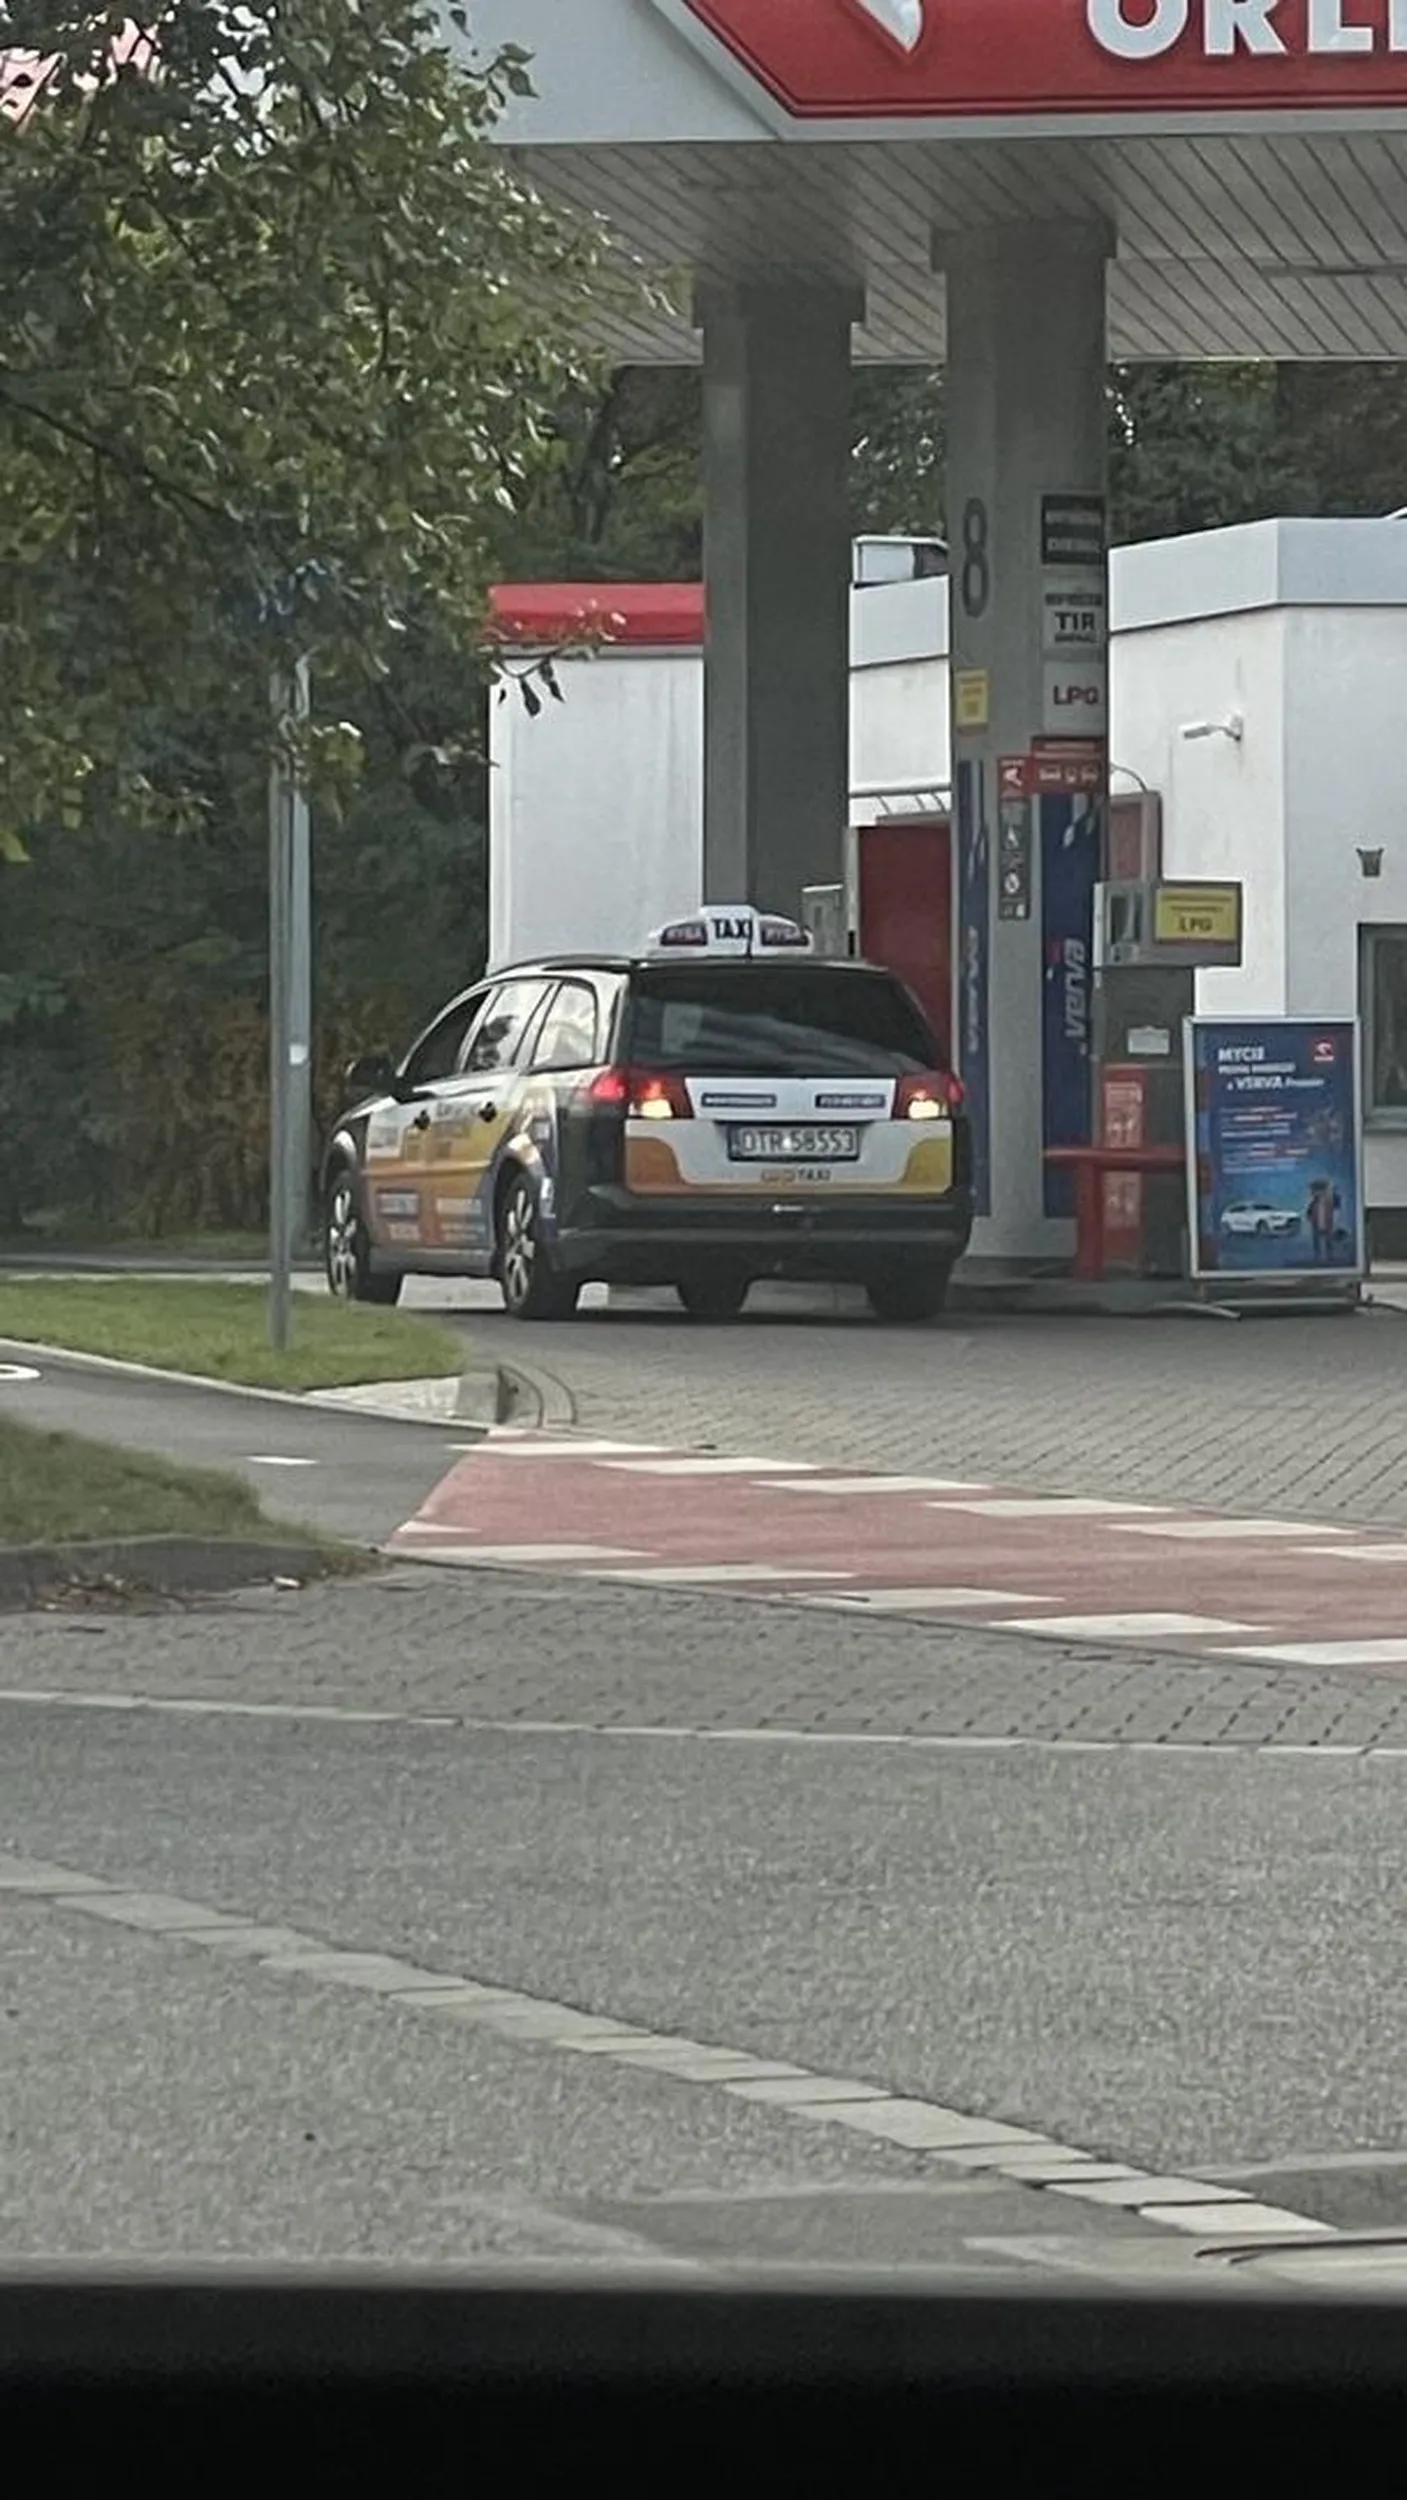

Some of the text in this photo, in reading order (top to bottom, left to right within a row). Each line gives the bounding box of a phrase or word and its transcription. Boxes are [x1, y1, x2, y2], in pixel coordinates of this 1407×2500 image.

[963, 497, 989, 619] 8
[1054, 612, 1095, 631] TIR
[1053, 685, 1099, 706] LPG
[711, 918, 753, 940] TAXI
[1179, 917, 1214, 932] LPG
[790, 1129, 855, 1153] 58553
